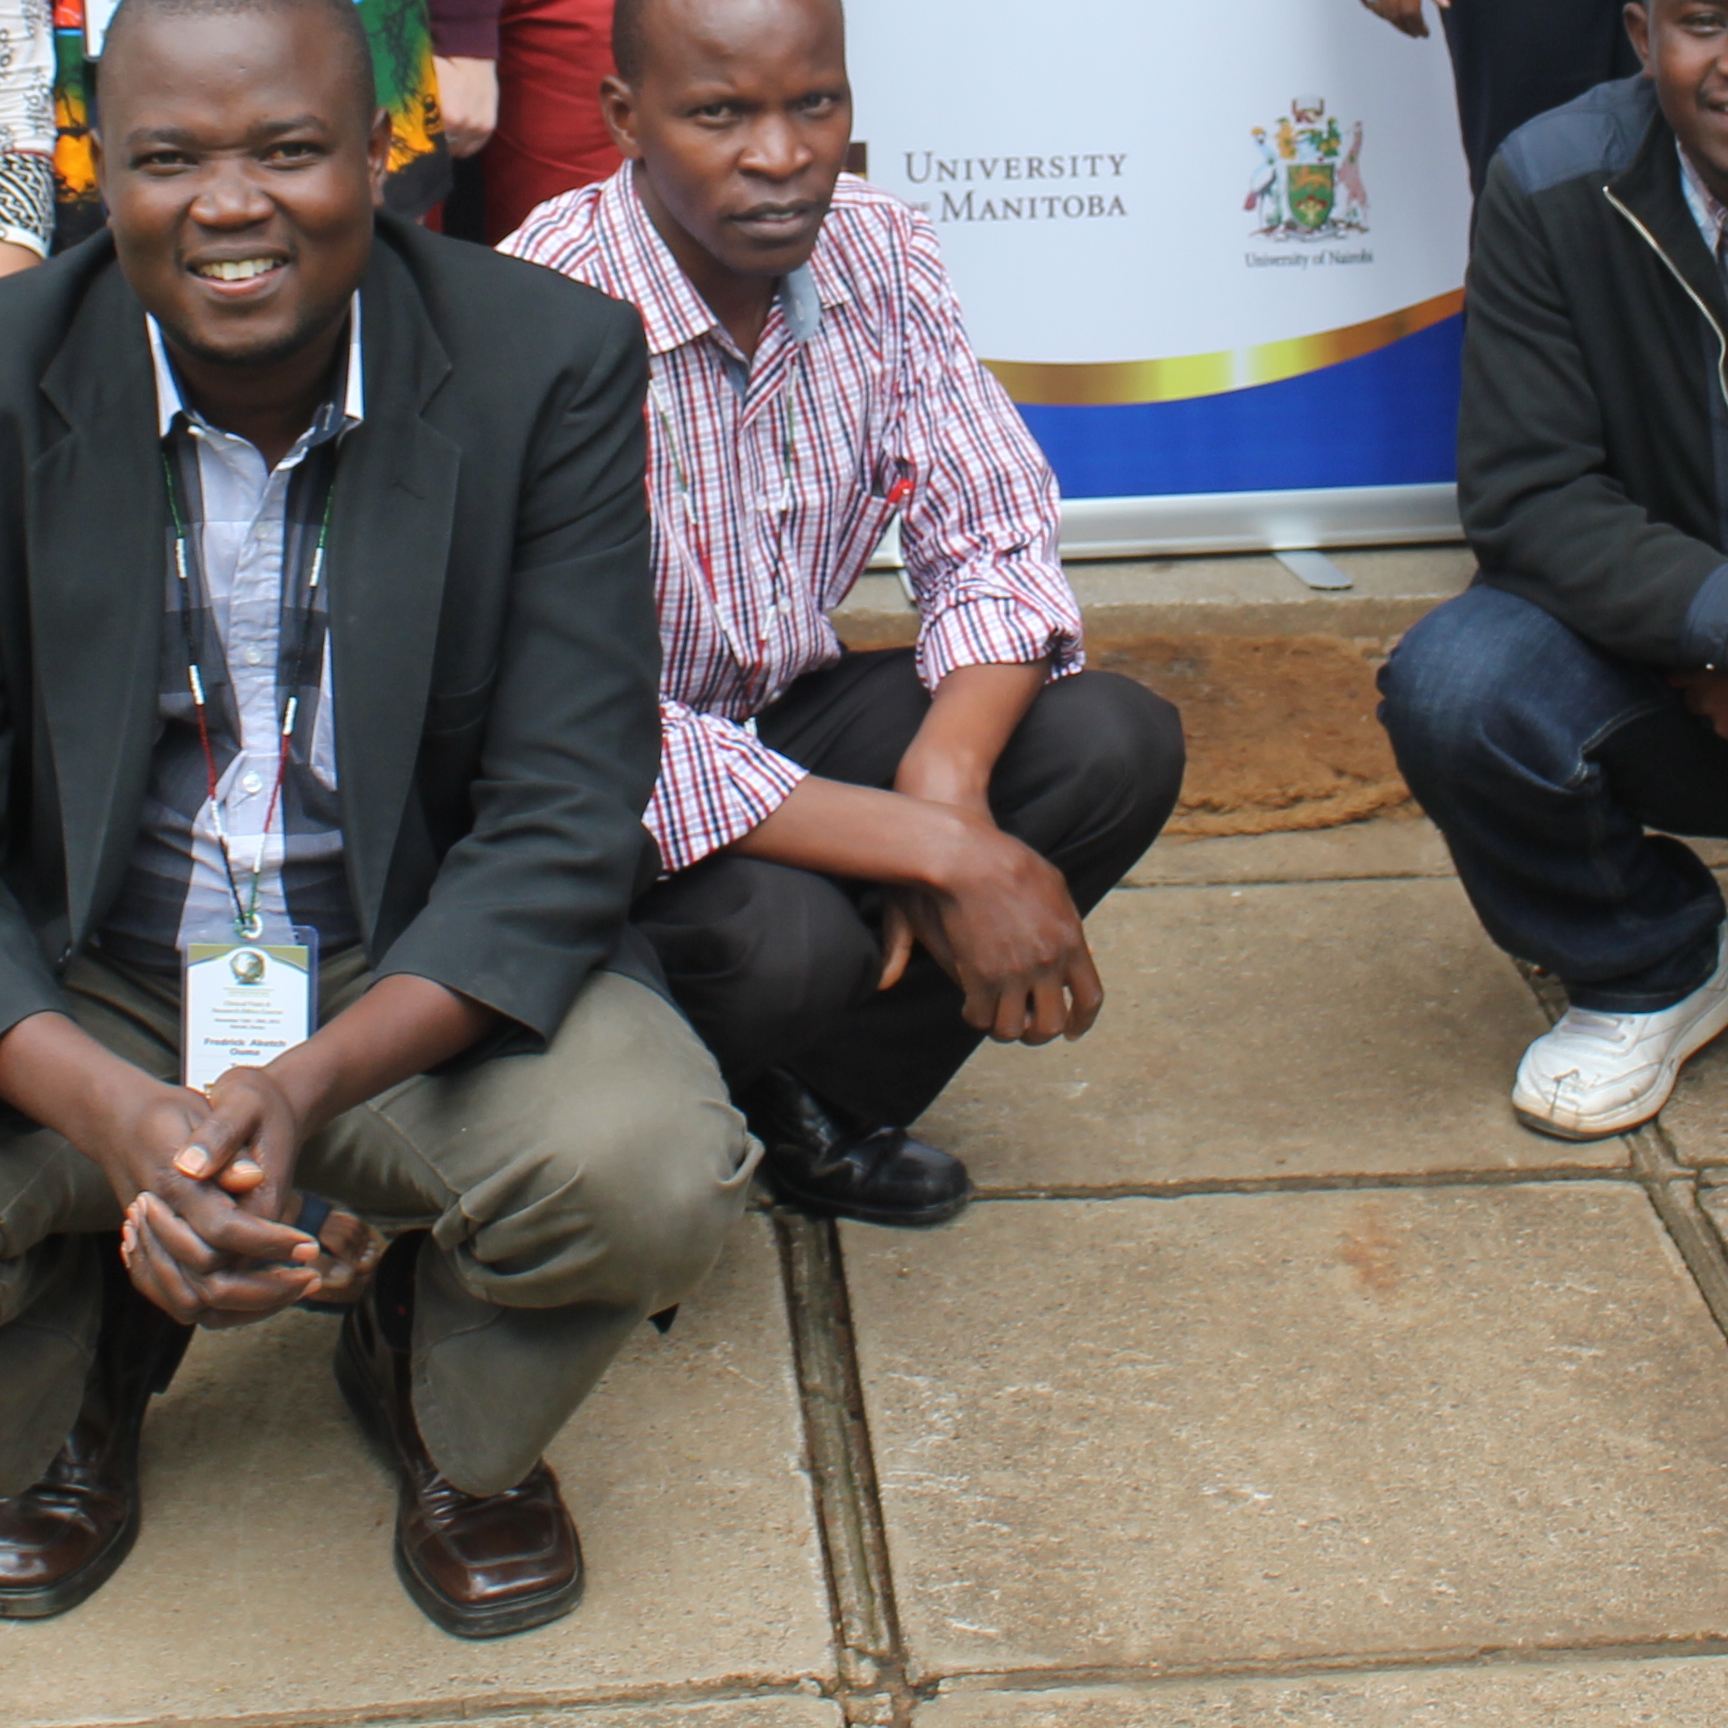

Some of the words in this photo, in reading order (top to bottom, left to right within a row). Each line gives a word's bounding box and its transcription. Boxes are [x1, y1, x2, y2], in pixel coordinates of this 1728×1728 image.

[940, 190, 1129, 224] MANITOBA
[1245, 253, 1309, 270] University
[1313, 251, 1326, 265] of
[1329, 249, 1374, 266] Nairobi
